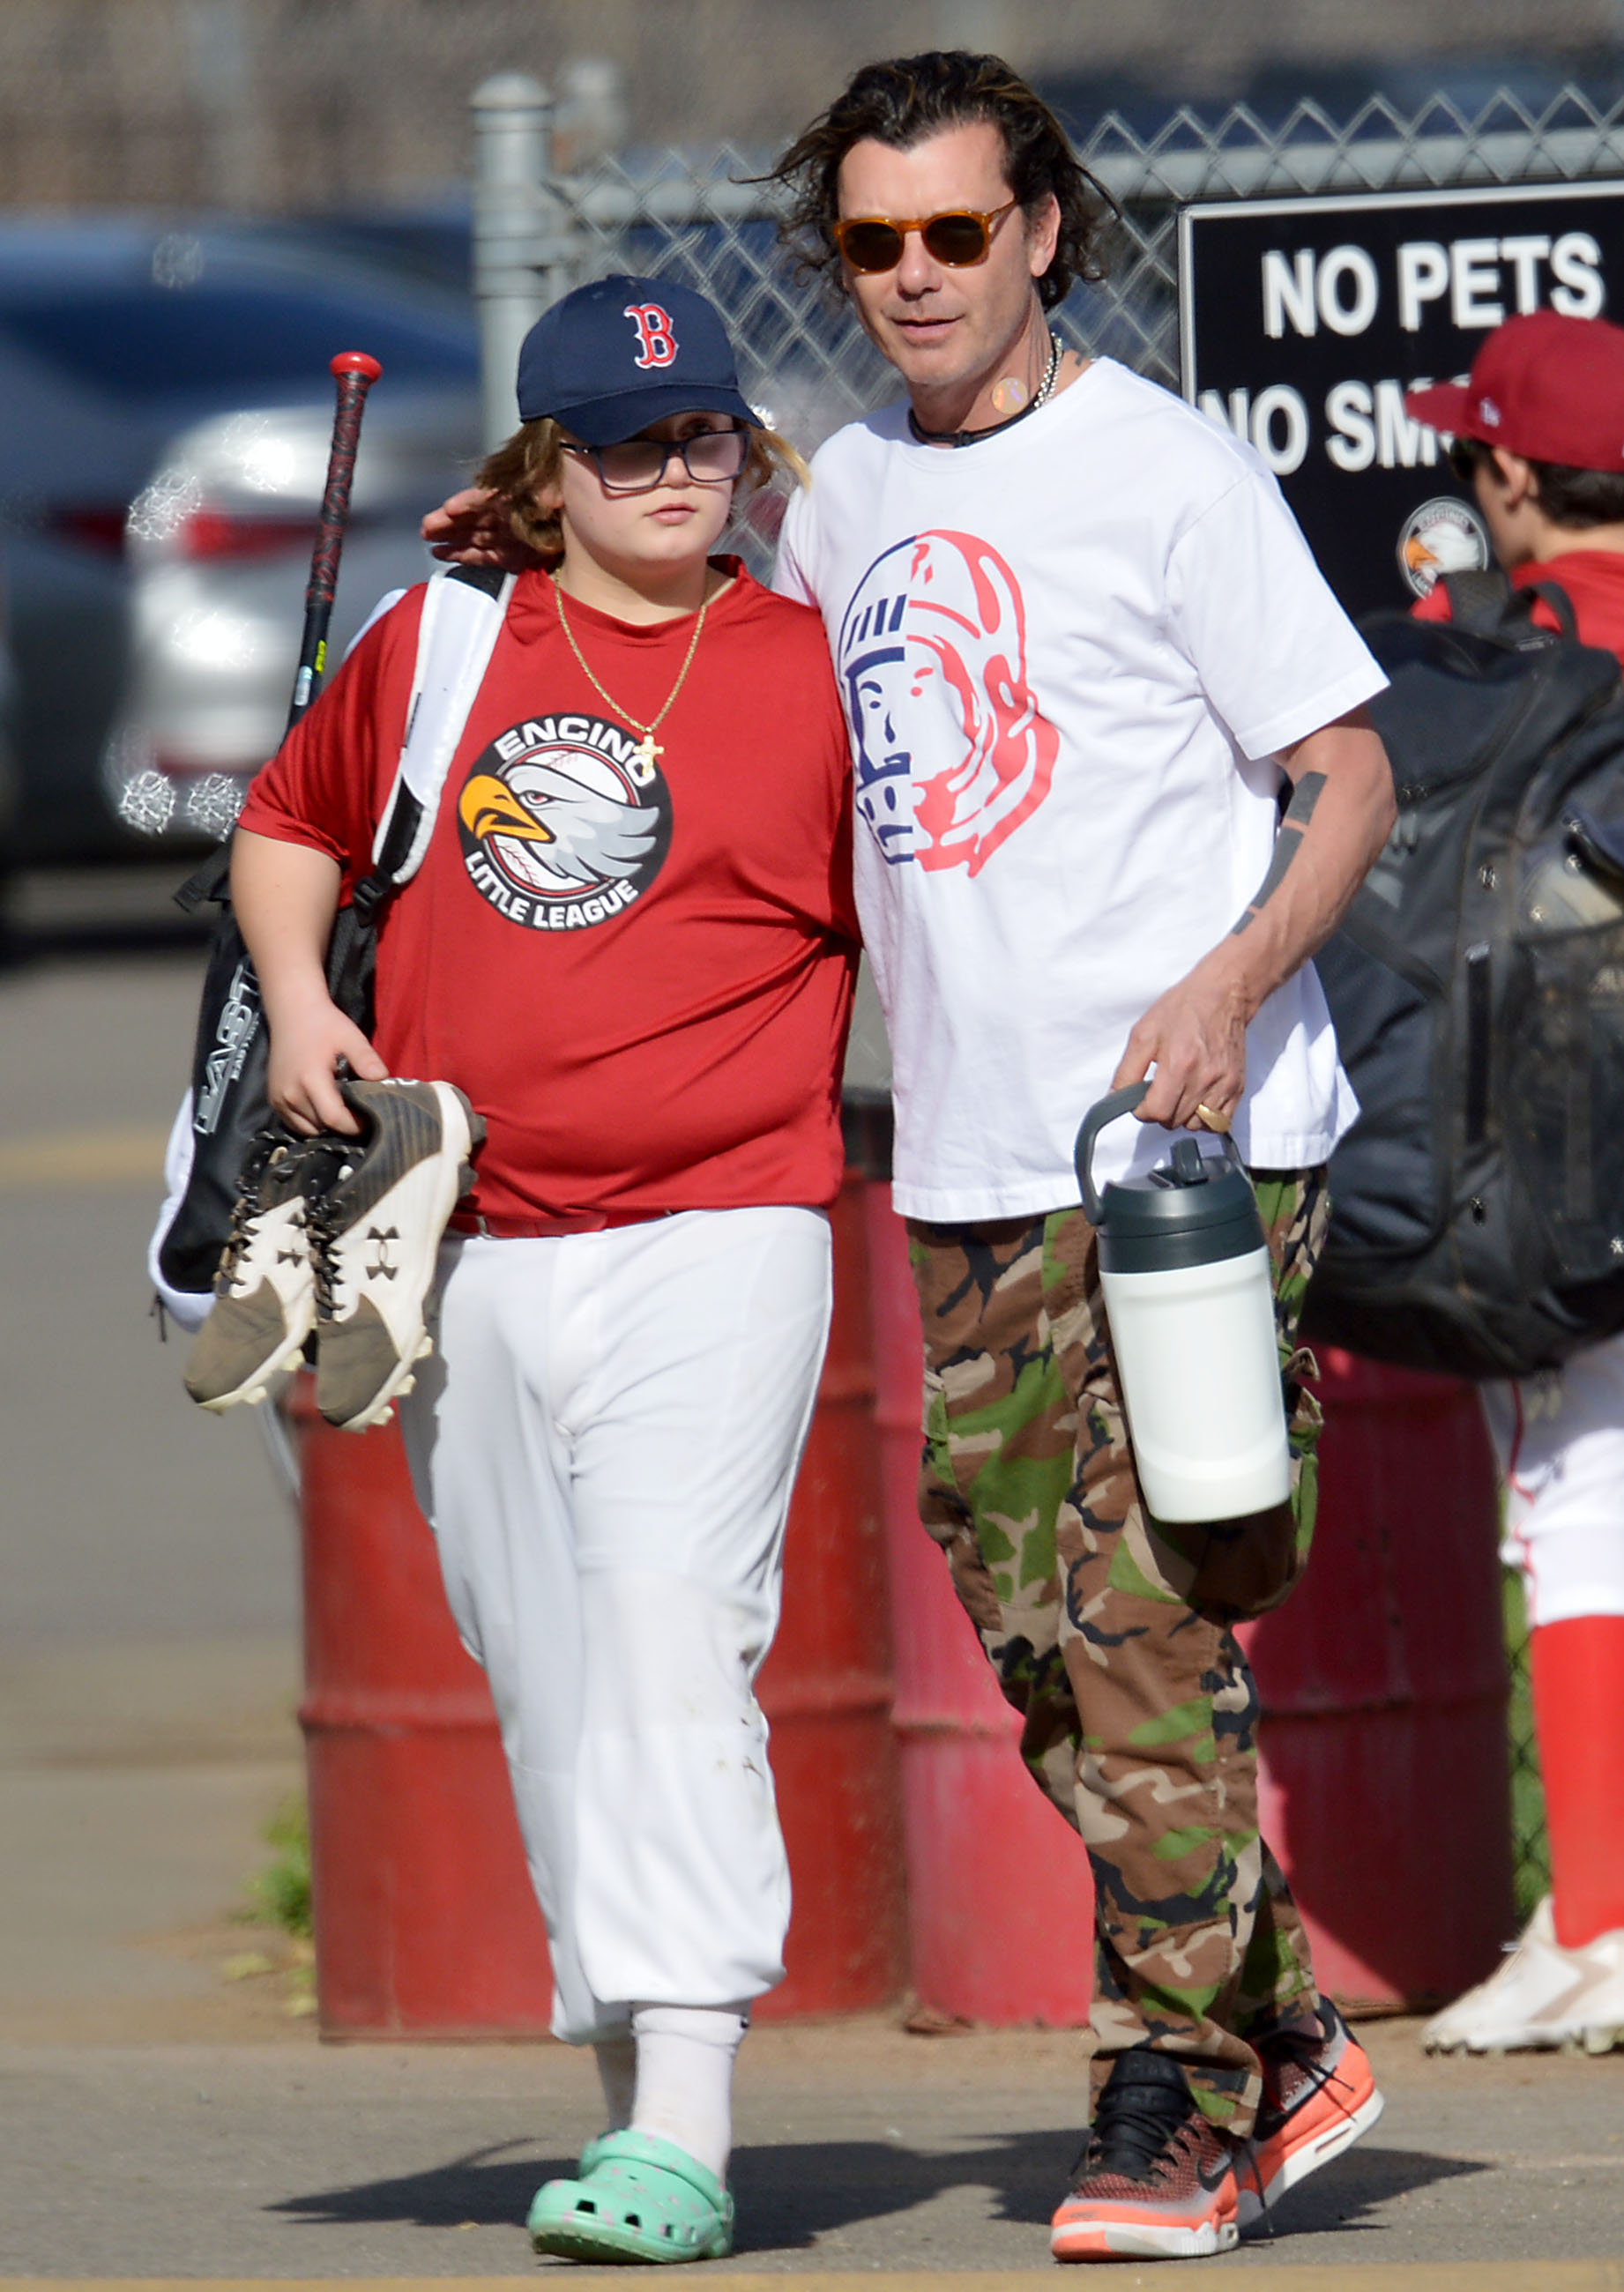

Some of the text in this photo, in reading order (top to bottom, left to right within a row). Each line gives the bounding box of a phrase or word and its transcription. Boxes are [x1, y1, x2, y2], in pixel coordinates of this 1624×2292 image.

[1262, 232, 1605, 339] NO PETS
[623, 303, 680, 368] B
[494, 717, 657, 787] ENCINO
[465, 852, 639, 930] LITTLE LEAGUE
